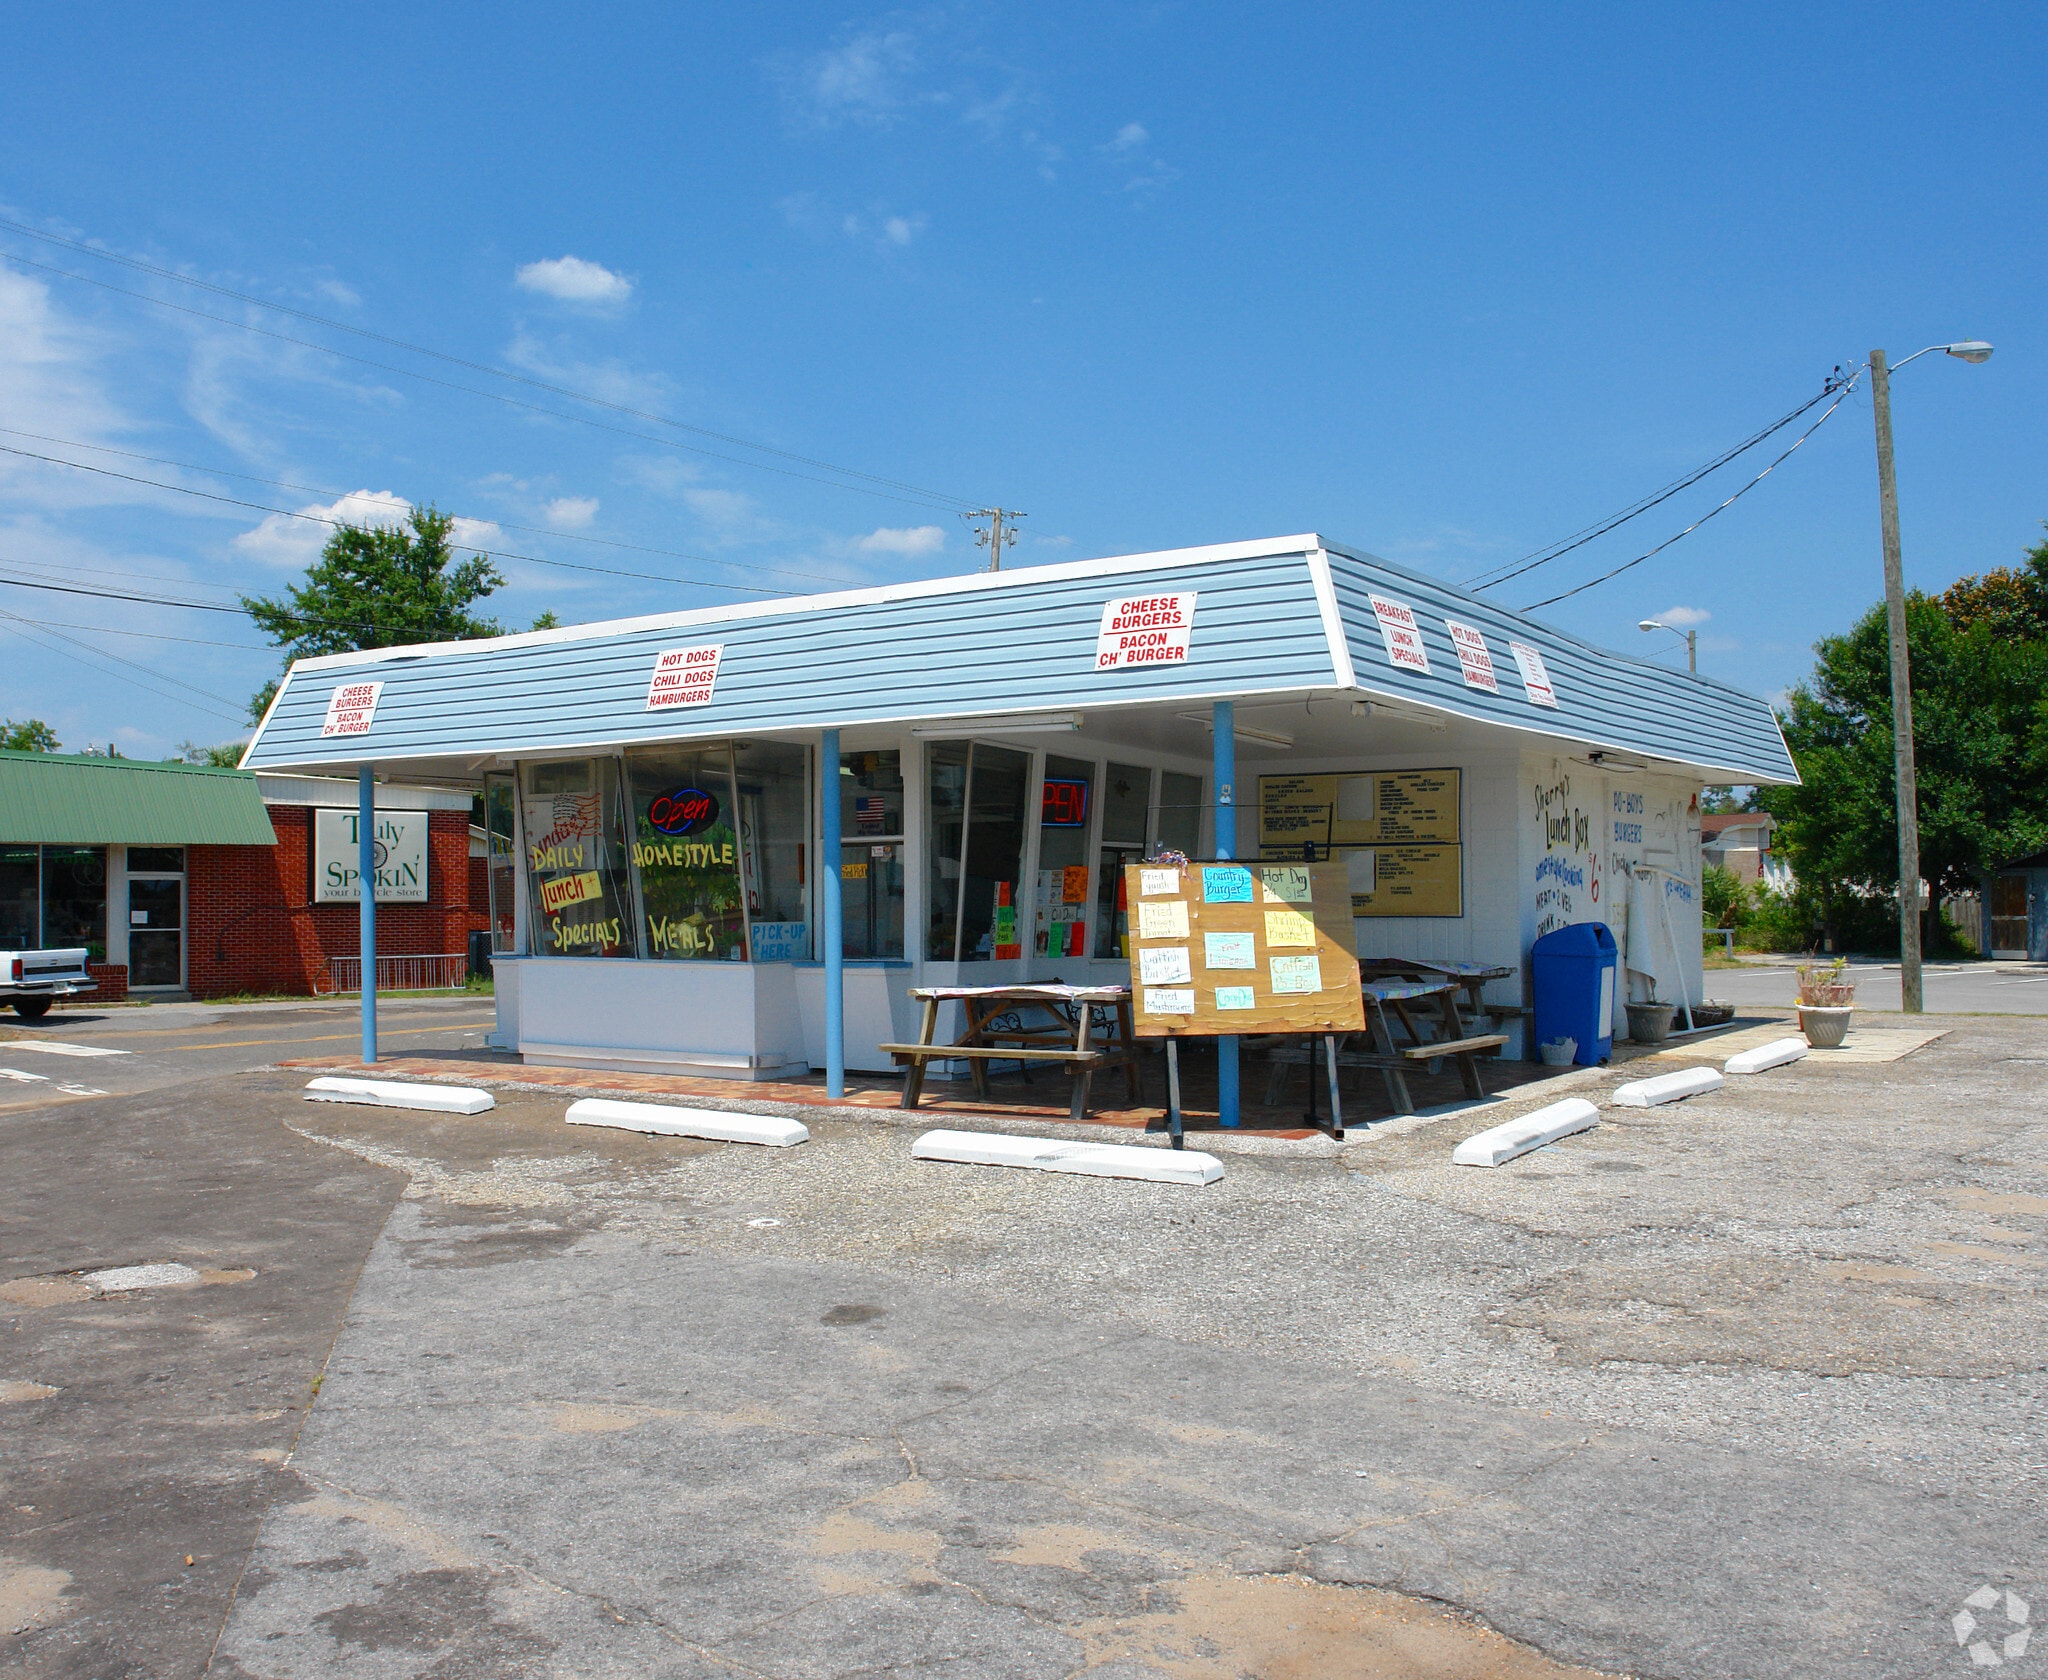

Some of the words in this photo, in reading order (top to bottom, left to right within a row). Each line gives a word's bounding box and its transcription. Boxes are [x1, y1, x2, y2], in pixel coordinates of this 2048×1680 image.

[1121, 597, 1179, 615] CHEESE
[1373, 601, 1413, 624] BREAKFAST
[1112, 611, 1182, 630] BURGERS
[1119, 632, 1168, 649] BACON
[1390, 629, 1415, 647] LUNCH
[1450, 625, 1464, 640] HOT
[1464, 629, 1482, 645] DOGS
[661, 653, 683, 667] HOT
[686, 649, 717, 664] DOGS
[1100, 652, 1122, 666] CH'
[1127, 646, 1184, 662] BURGER
[1391, 647, 1425, 667] SPECIALS
[1458, 648, 1473, 663] CHILI
[1473, 652, 1491, 668] DOGS
[654, 674, 681, 687] CHILI
[684, 670, 715, 684] DOGS
[1464, 669, 1496, 689] HAMBURGERS
[342, 685, 374, 698] CHEESE
[649, 689, 710, 707] HAMBURGERS
[335, 696, 373, 709] BURGERS
[337, 711, 363, 723] BACON
[337, 722, 370, 733] BURGER
[1042, 783, 1086, 822] PEN
[1613, 790, 1644, 815] PO-BOYS
[650, 797, 711, 830] Open
[342, 815, 405, 850] Tuly
[1545, 808, 1570, 850] Lunch
[1574, 807, 1589, 855] Box
[1614, 821, 1643, 844] BURGERS
[532, 844, 583, 871] DAILY
[632, 841, 733, 869] HOMESTYLE
[1142, 870, 1163, 881] Fried
[1203, 867, 1244, 888] Country
[1261, 867, 1284, 882] Hot
[1289, 867, 1307, 892] Dog
[324, 889, 348, 898] your
[396, 889, 423, 897] store
[541, 872, 585, 916] lunch
[1205, 881, 1241, 900] Burger
[1145, 903, 1171, 917] Fried
[1266, 911, 1306, 931] Shrimp
[752, 924, 806, 940] PICK-UP
[1269, 926, 1310, 942] Basket
[760, 943, 792, 961] HERE
[1154, 990, 1177, 1001] Fried
